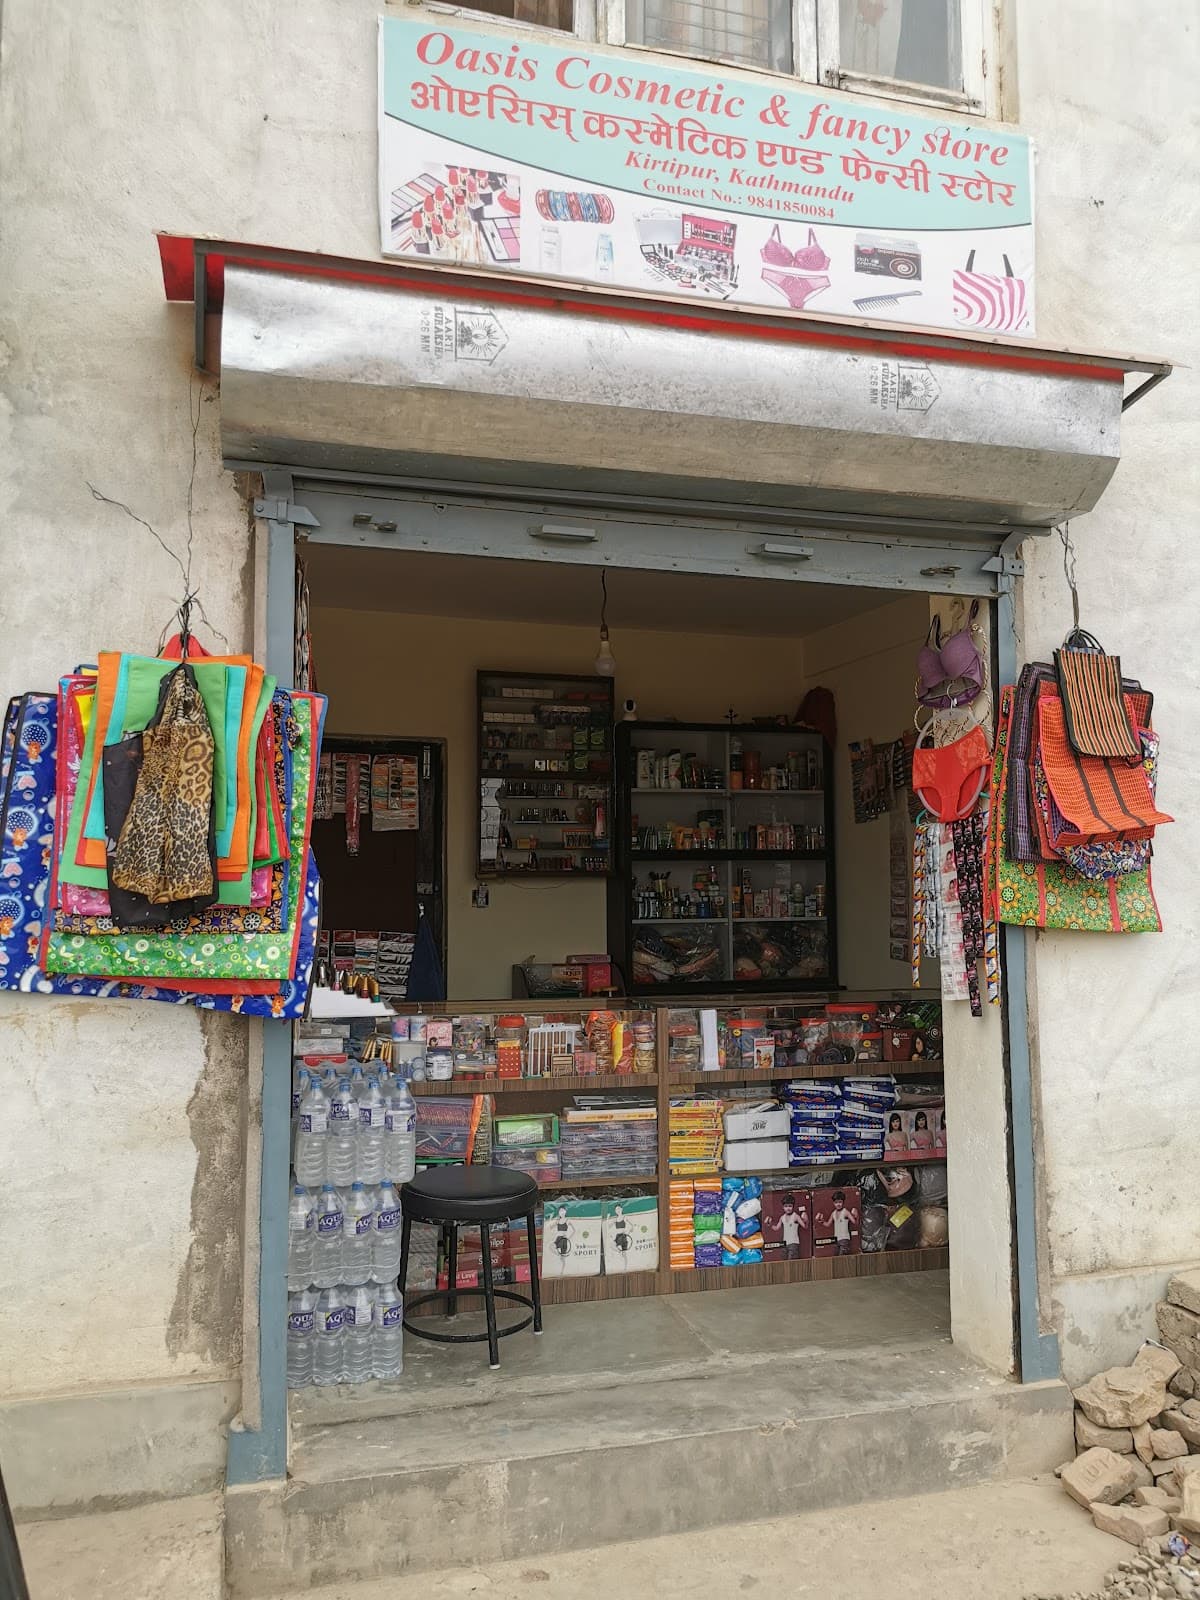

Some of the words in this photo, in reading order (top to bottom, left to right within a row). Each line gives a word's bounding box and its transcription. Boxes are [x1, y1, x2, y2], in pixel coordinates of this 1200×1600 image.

[415, 32, 539, 82] Oasis
[555, 57, 745, 118] Cosmetic
[759, 94, 791, 128] &
[799, 104, 911, 155] fancy
[921, 126, 1009, 166] store
[583, 110, 748, 160] कस्मेटिक
[756, 140, 832, 175] एण्ड
[840, 148, 931, 194] फेन्सी
[938, 170, 1016, 207] स्टोर
[625, 150, 720, 183] Kirtipur,
[728, 168, 855, 204] Kathmandu
[643, 178, 706, 199] Contact
[747, 194, 836, 219] 9841850084
[434, 306, 444, 360] SURAKSHA
[444, 317, 454, 352] AARTI
[880, 362, 890, 410] SURAKSHA
[889, 371, 897, 404] AARTI
